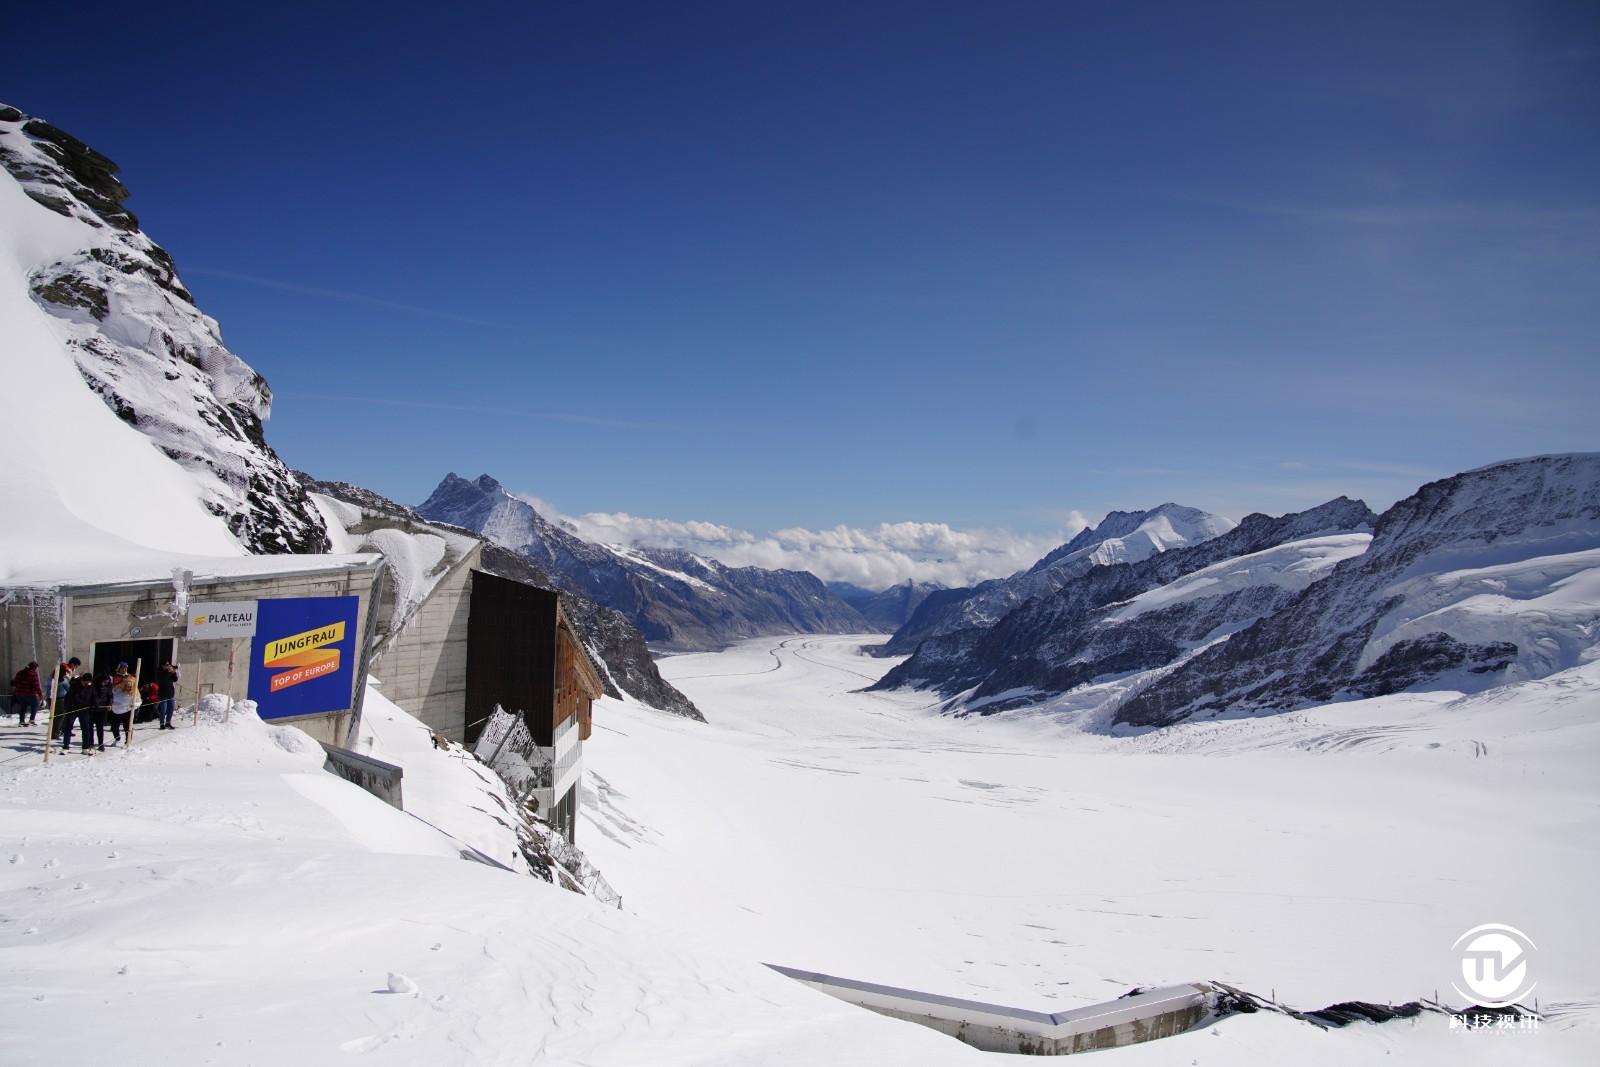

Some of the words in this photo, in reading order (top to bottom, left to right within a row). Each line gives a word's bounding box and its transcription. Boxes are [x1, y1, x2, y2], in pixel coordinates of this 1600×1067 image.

[208, 613, 252, 623] PLATEAU
[273, 629, 336, 658] JUNGFRAU
[274, 675, 291, 687] TOP
[292, 671, 303, 681] OF
[305, 661, 336, 677] EUROPE
